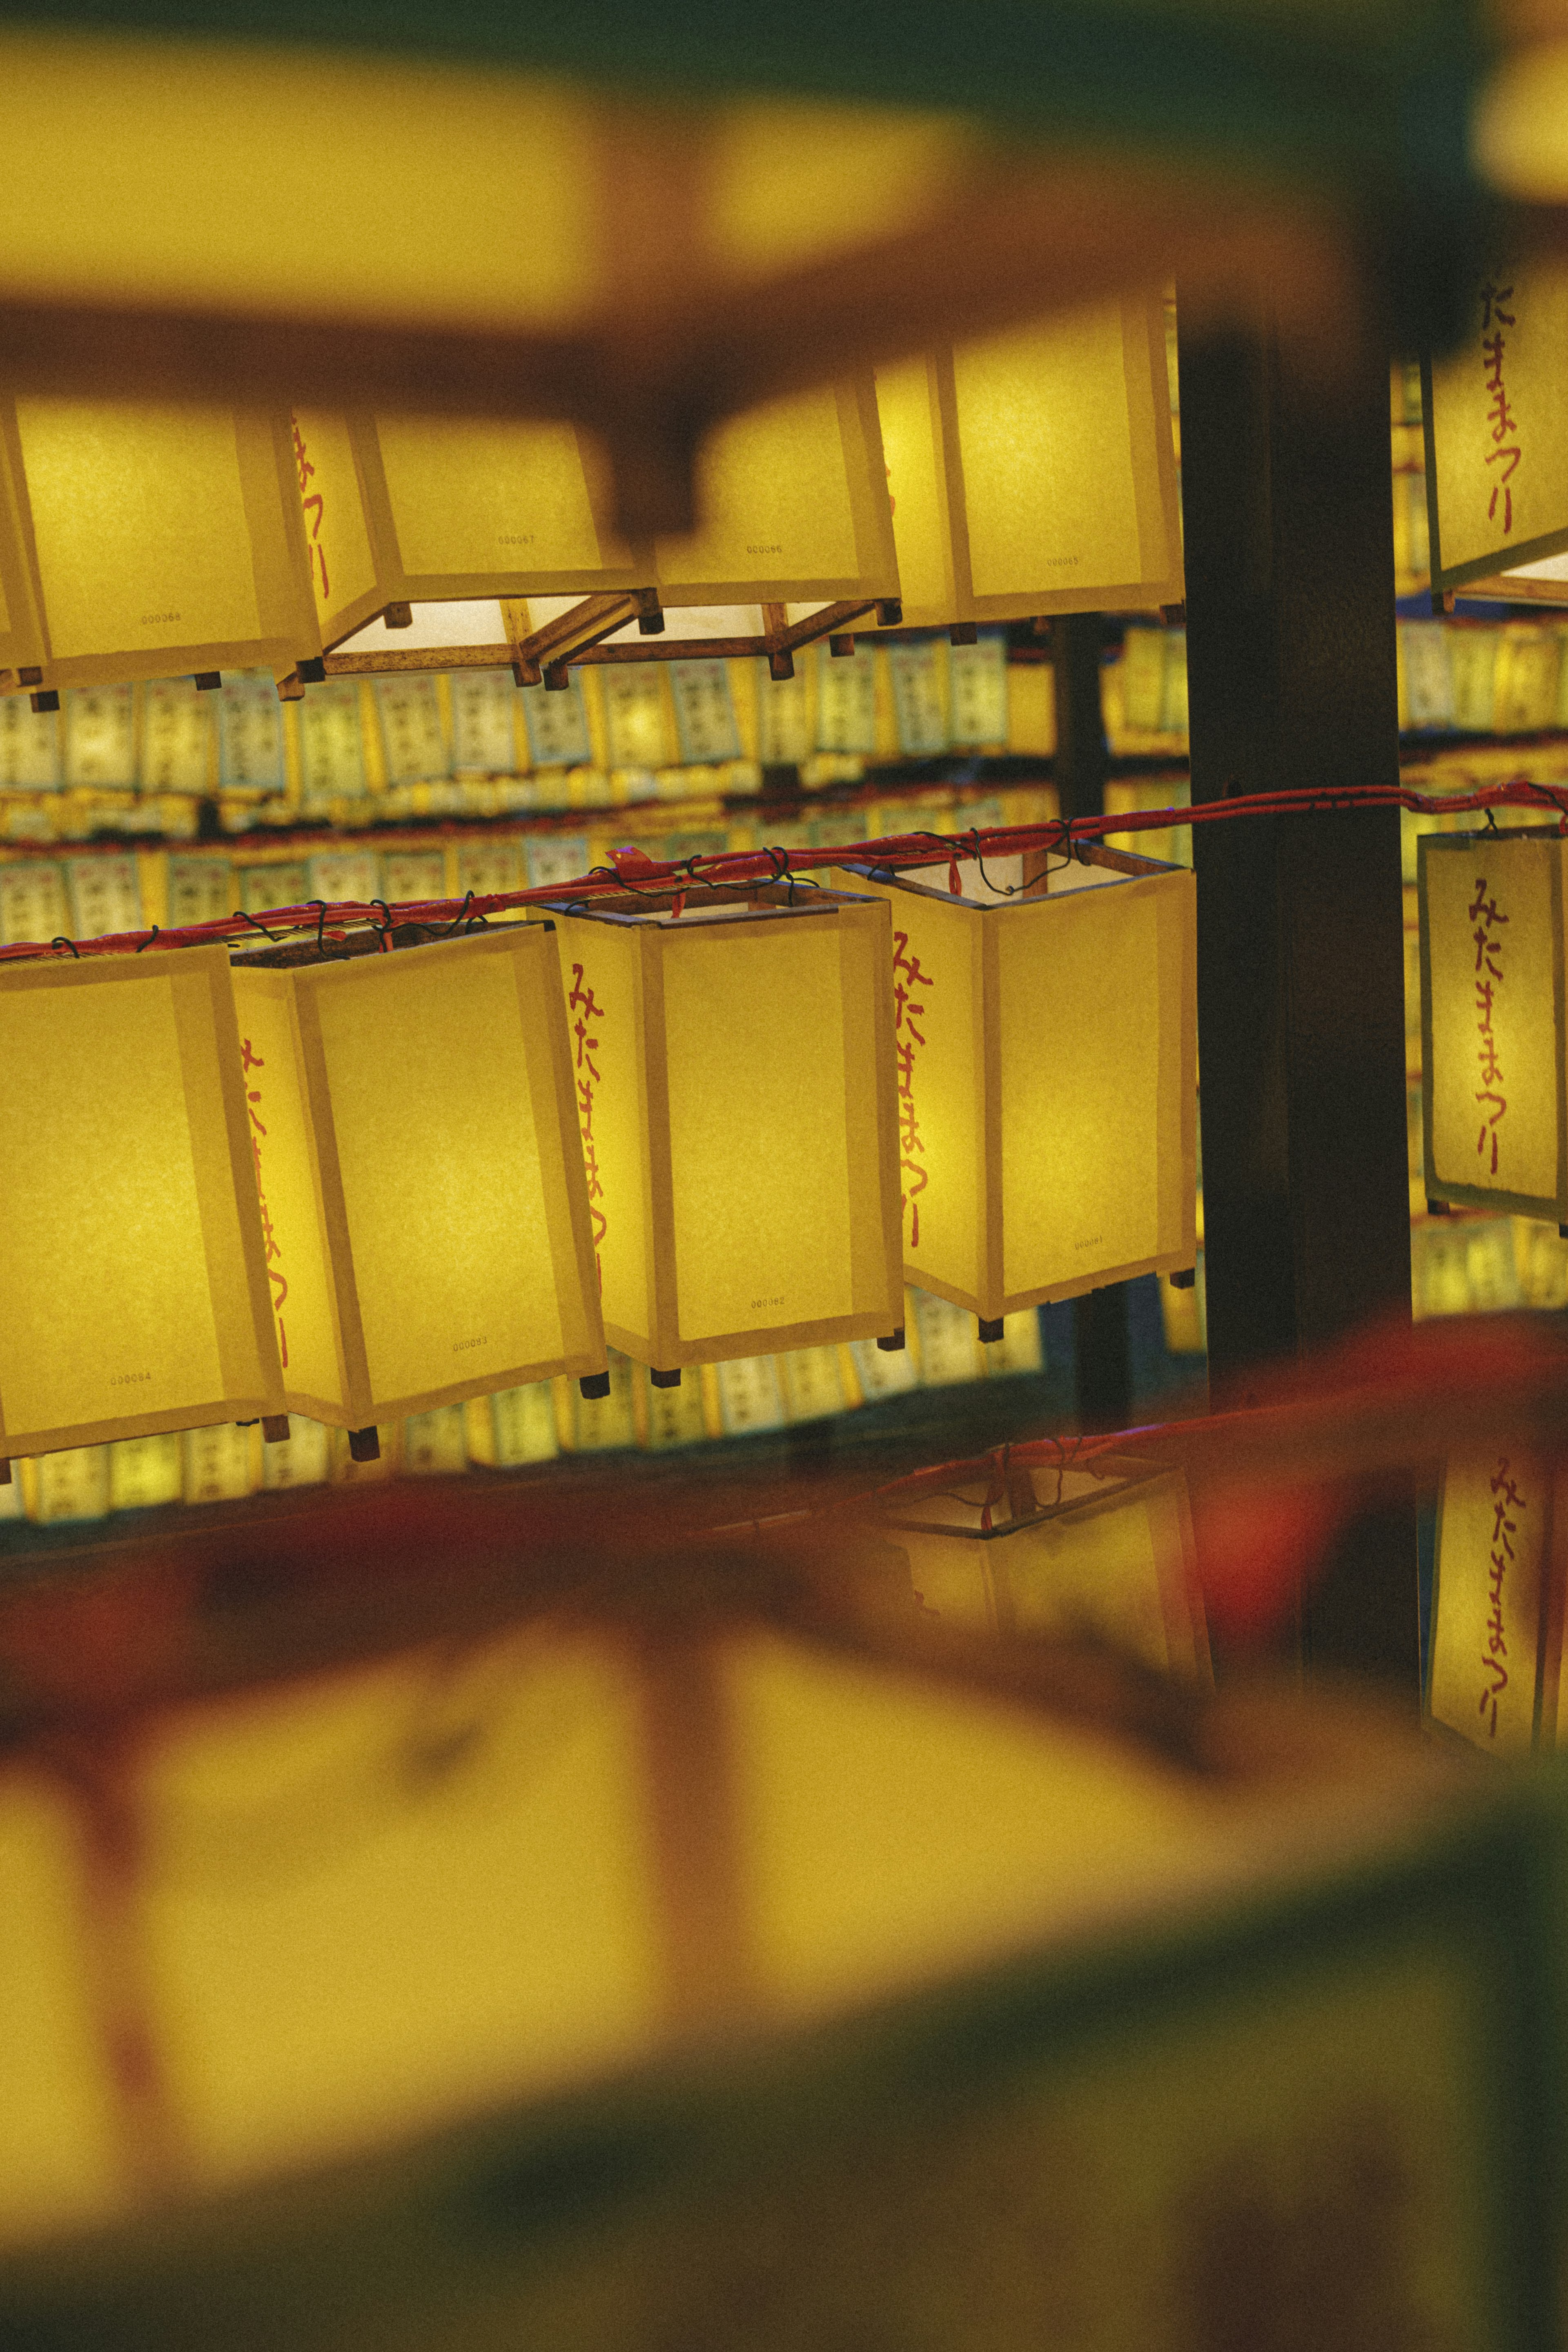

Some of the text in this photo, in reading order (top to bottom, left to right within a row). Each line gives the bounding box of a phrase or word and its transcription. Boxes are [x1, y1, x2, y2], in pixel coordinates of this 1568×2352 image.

[1480, 261, 1521, 534] たままつり
[1468, 878, 1509, 1175] みたままつり
[1479, 1456, 1526, 1738] みたままつり
